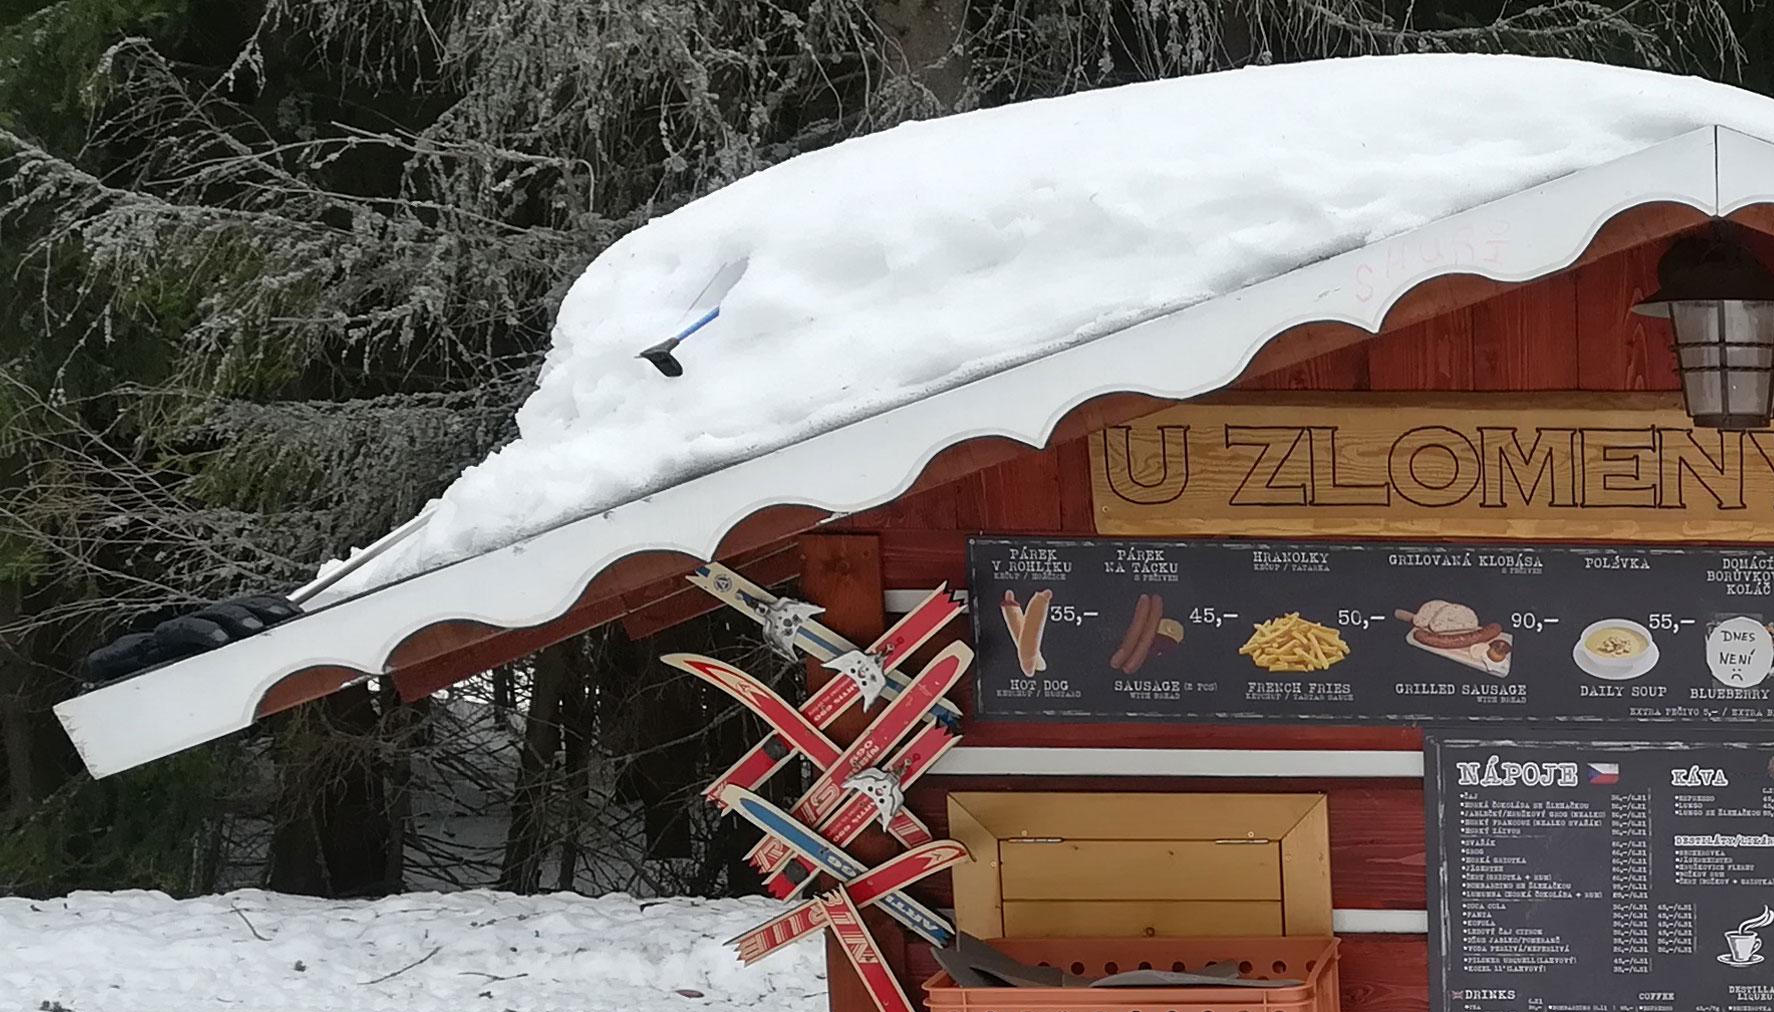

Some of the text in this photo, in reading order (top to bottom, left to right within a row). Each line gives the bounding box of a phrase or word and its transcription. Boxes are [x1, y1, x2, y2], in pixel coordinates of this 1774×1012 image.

[1102, 424, 1191, 505] U
[1010, 546, 1058, 561] PÁREK
[1117, 546, 1165, 562] PÁREK
[1253, 551, 1330, 564] HRANOLKY
[1388, 553, 1543, 567] GRILOVANÁ KLOBÁSA
[992, 559, 1072, 573] V ROHLÍKU
[1104, 559, 1179, 574] NA TÁCKU
[1584, 555, 1651, 569] POLÉVKA
[1722, 555, 1774, 569] DOMÁCÍ
[1726, 581, 1772, 595] KOLÁČ
[1720, 630, 1756, 642] DNES
[1719, 648, 1757, 665] NENÍ
[1010, 680, 1069, 691] HOT DOG
[1113, 680, 1181, 692] SAUSAGE
[1248, 682, 1351, 694] FRENCH FRIES
[1395, 684, 1527, 696] GRILLED SAUSAGE
[1580, 686, 1668, 697] DAILY SOUP
[1689, 688, 1770, 700] BLUEBERRY
[1456, 755, 1579, 787] NÁPOJE
[1671, 765, 1729, 787] KÁVA
[1465, 990, 1517, 1000] DRINKS
